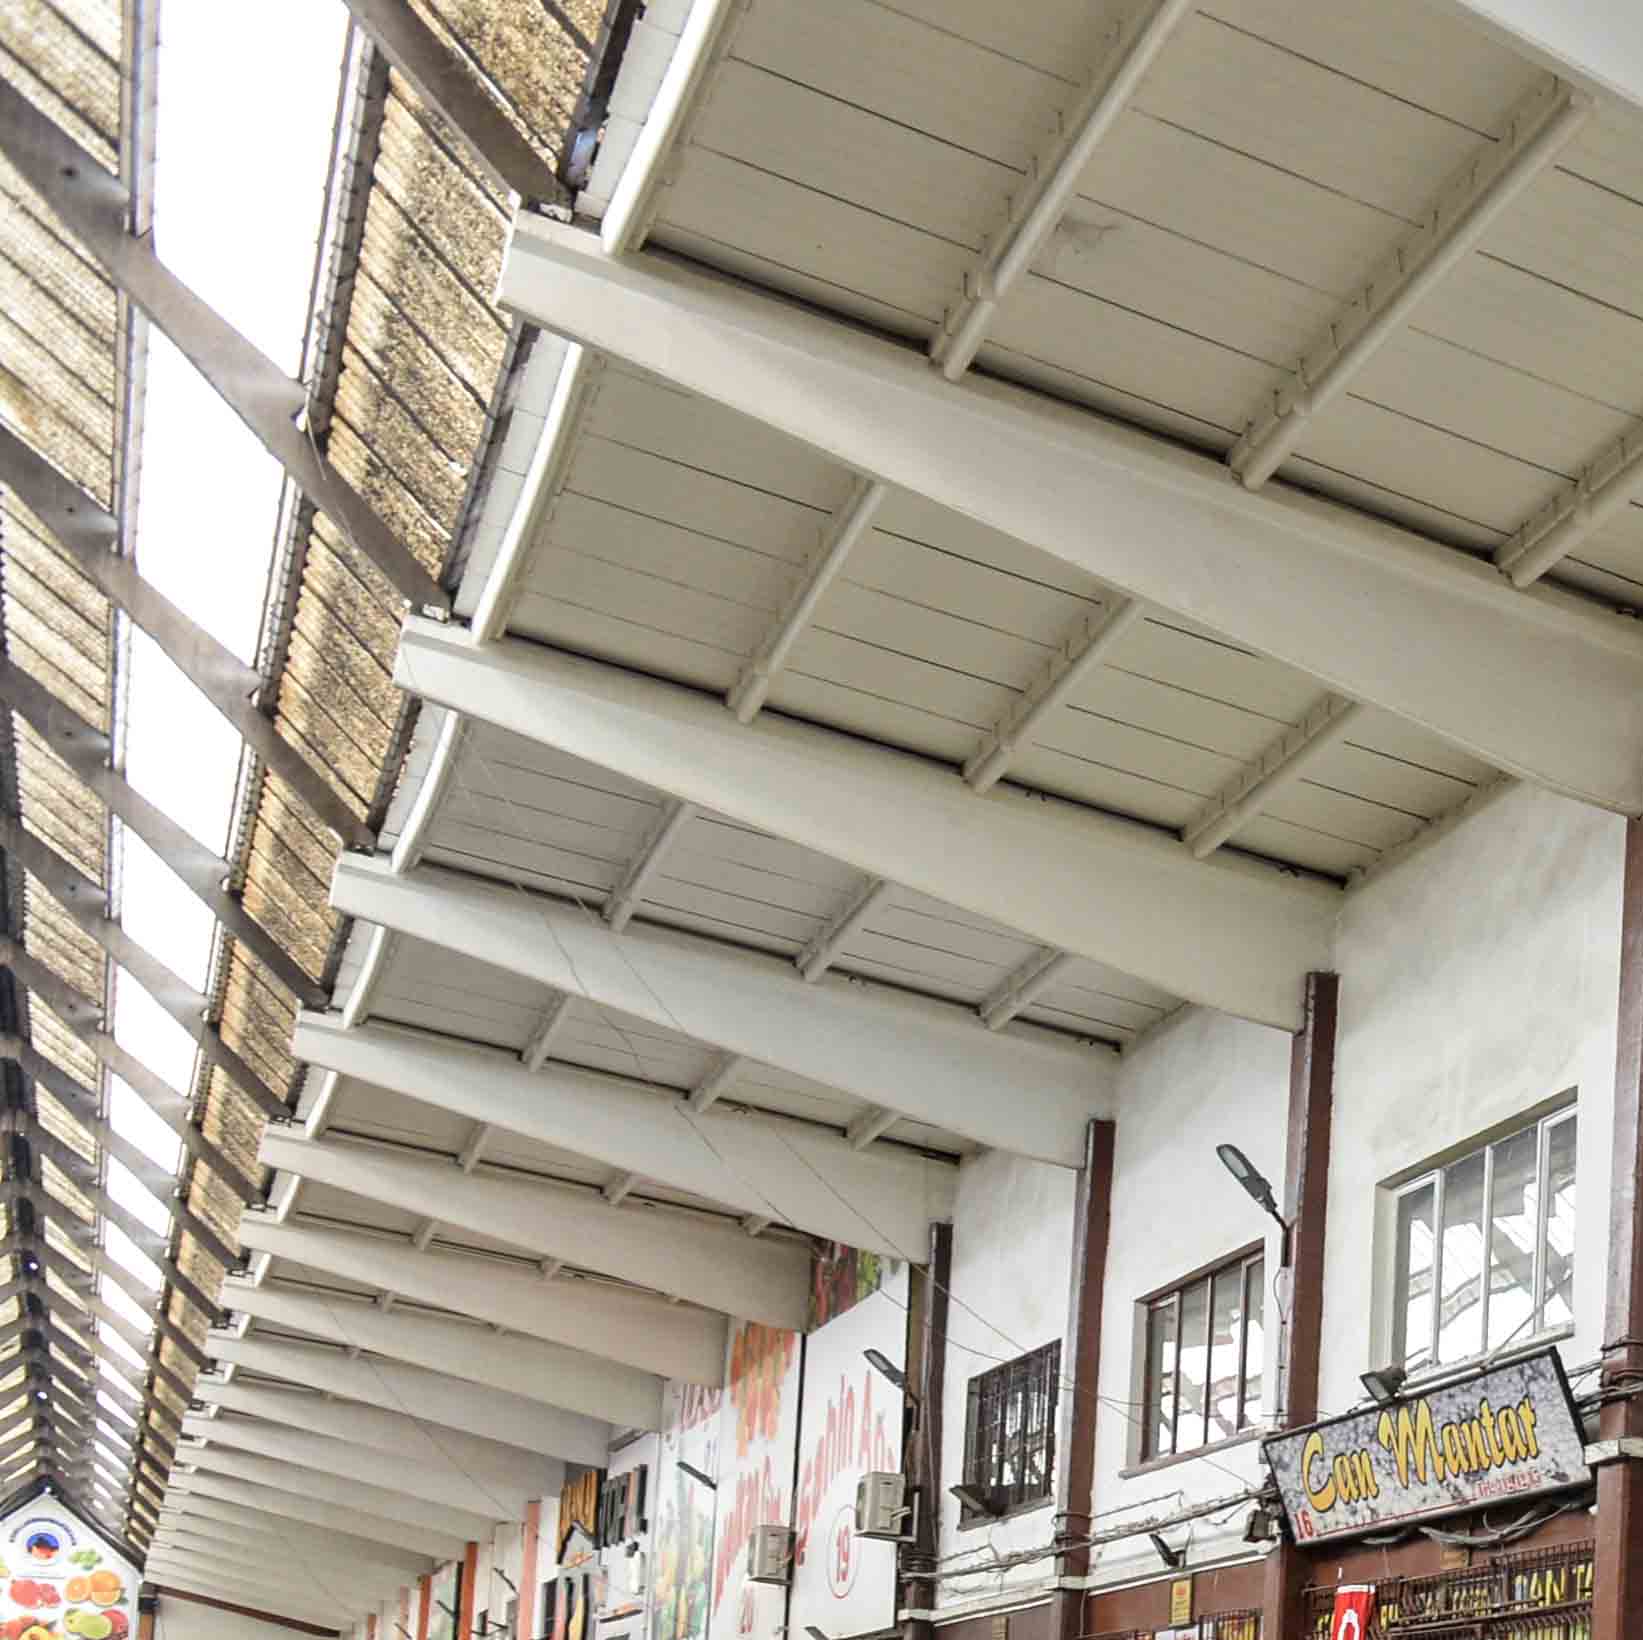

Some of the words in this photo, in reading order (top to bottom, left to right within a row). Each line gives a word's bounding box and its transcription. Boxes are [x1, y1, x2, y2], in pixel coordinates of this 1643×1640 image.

[1302, 1430, 1379, 1512] Can
[1378, 1397, 1539, 1488] Mantar
[1295, 1509, 1313, 1539] 16
